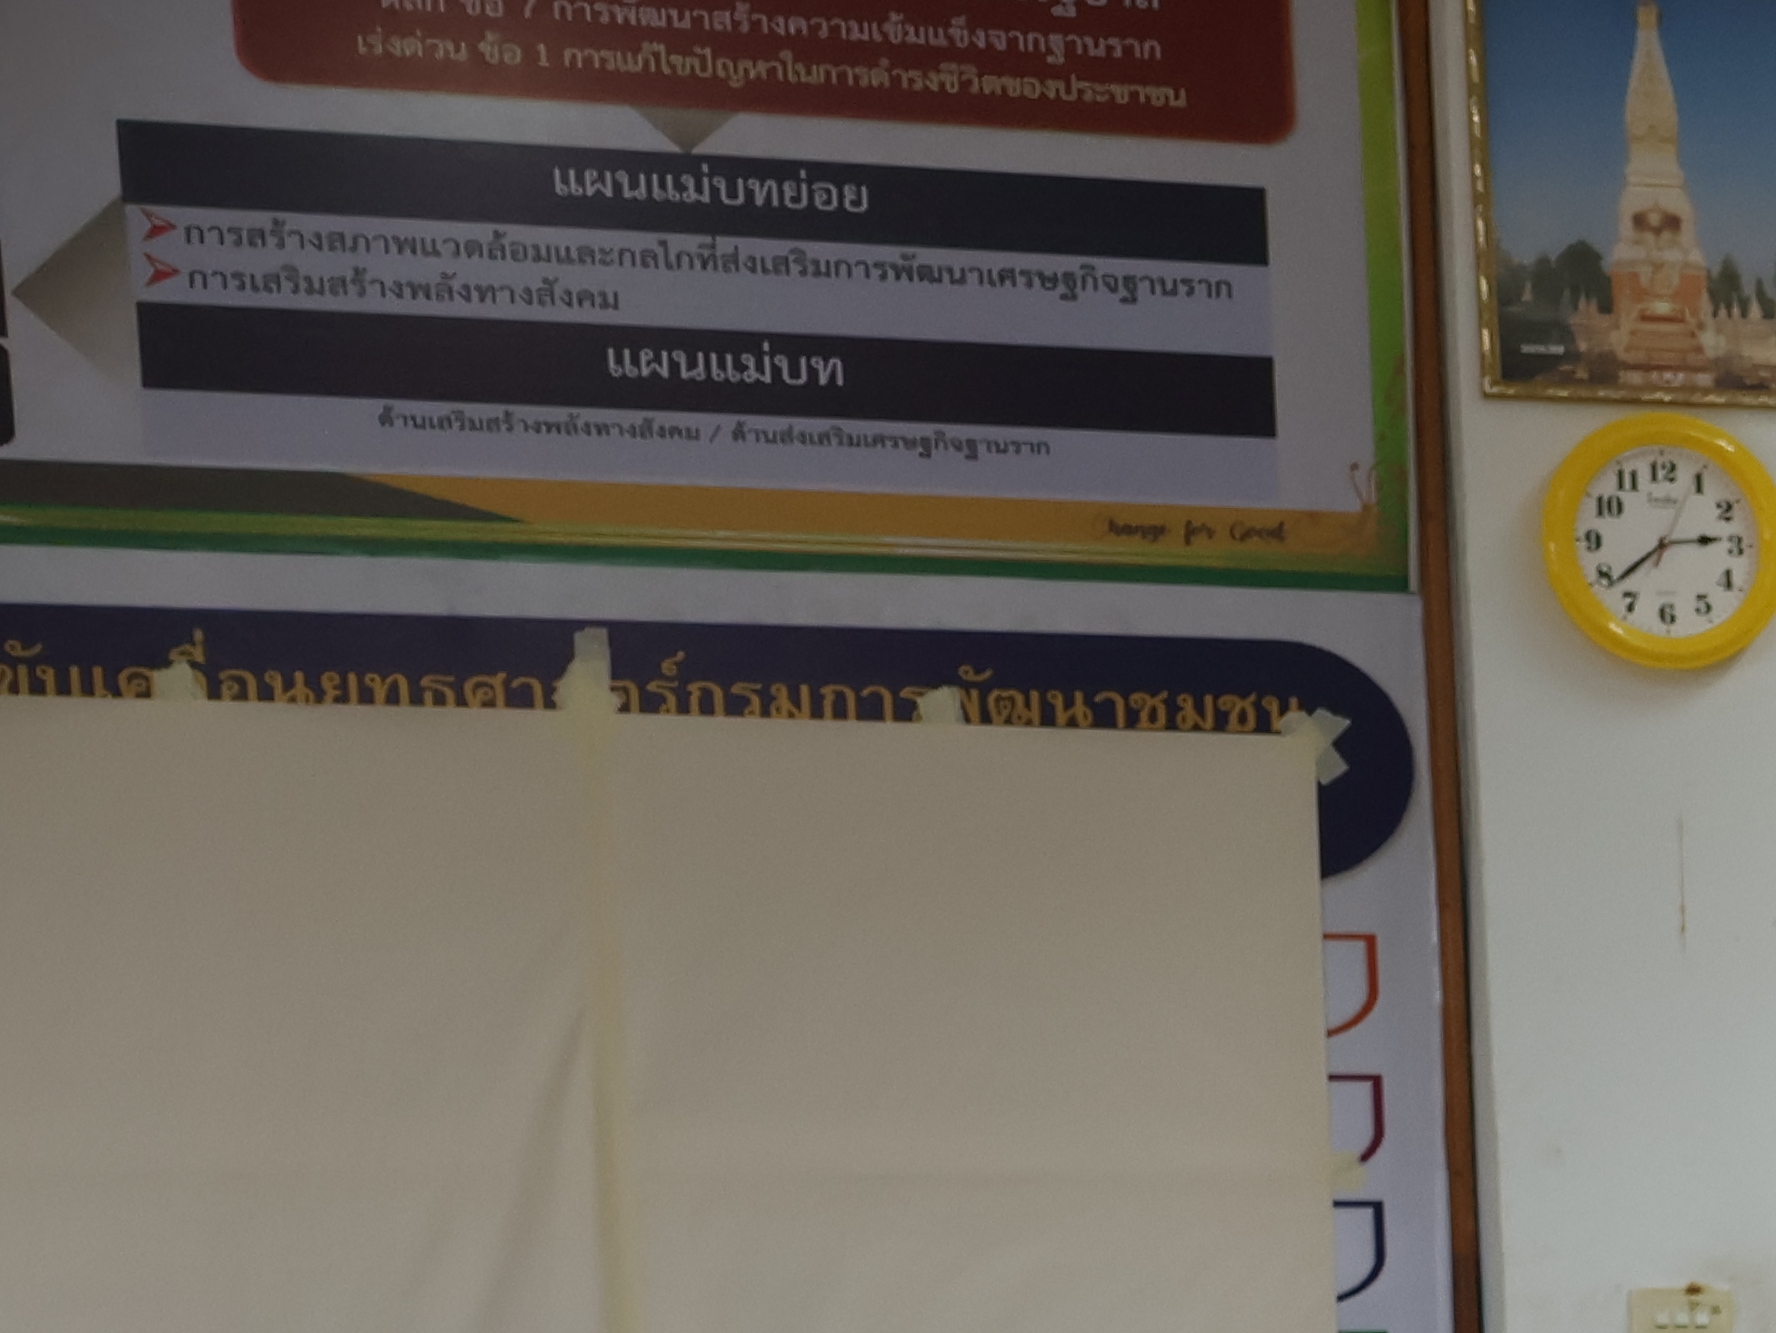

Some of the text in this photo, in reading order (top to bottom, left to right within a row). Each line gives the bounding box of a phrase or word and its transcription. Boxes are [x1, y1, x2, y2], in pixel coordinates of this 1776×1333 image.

[477, 32, 522, 66] ข้อ
[537, 43, 550, 68] 1
[551, 163, 870, 214] แผนแม่บทย่อย
[188, 264, 621, 313] การเสริมสร้างพลังทางสังคม
[605, 342, 845, 387] แผนแม่บท
[1616, 468, 1639, 492] 11
[1650, 460, 1677, 484] 12
[1693, 471, 1705, 495] 1
[1595, 494, 1624, 519] 10
[1715, 499, 1734, 522] 2
[1584, 528, 1603, 552] 9
[1727, 534, 1745, 557] 3
[1595, 562, 1614, 588] 8
[1715, 567, 1733, 591] 4
[1622, 590, 1640, 613] 7
[1658, 602, 1677, 625] 6
[1694, 593, 1713, 616] 5
